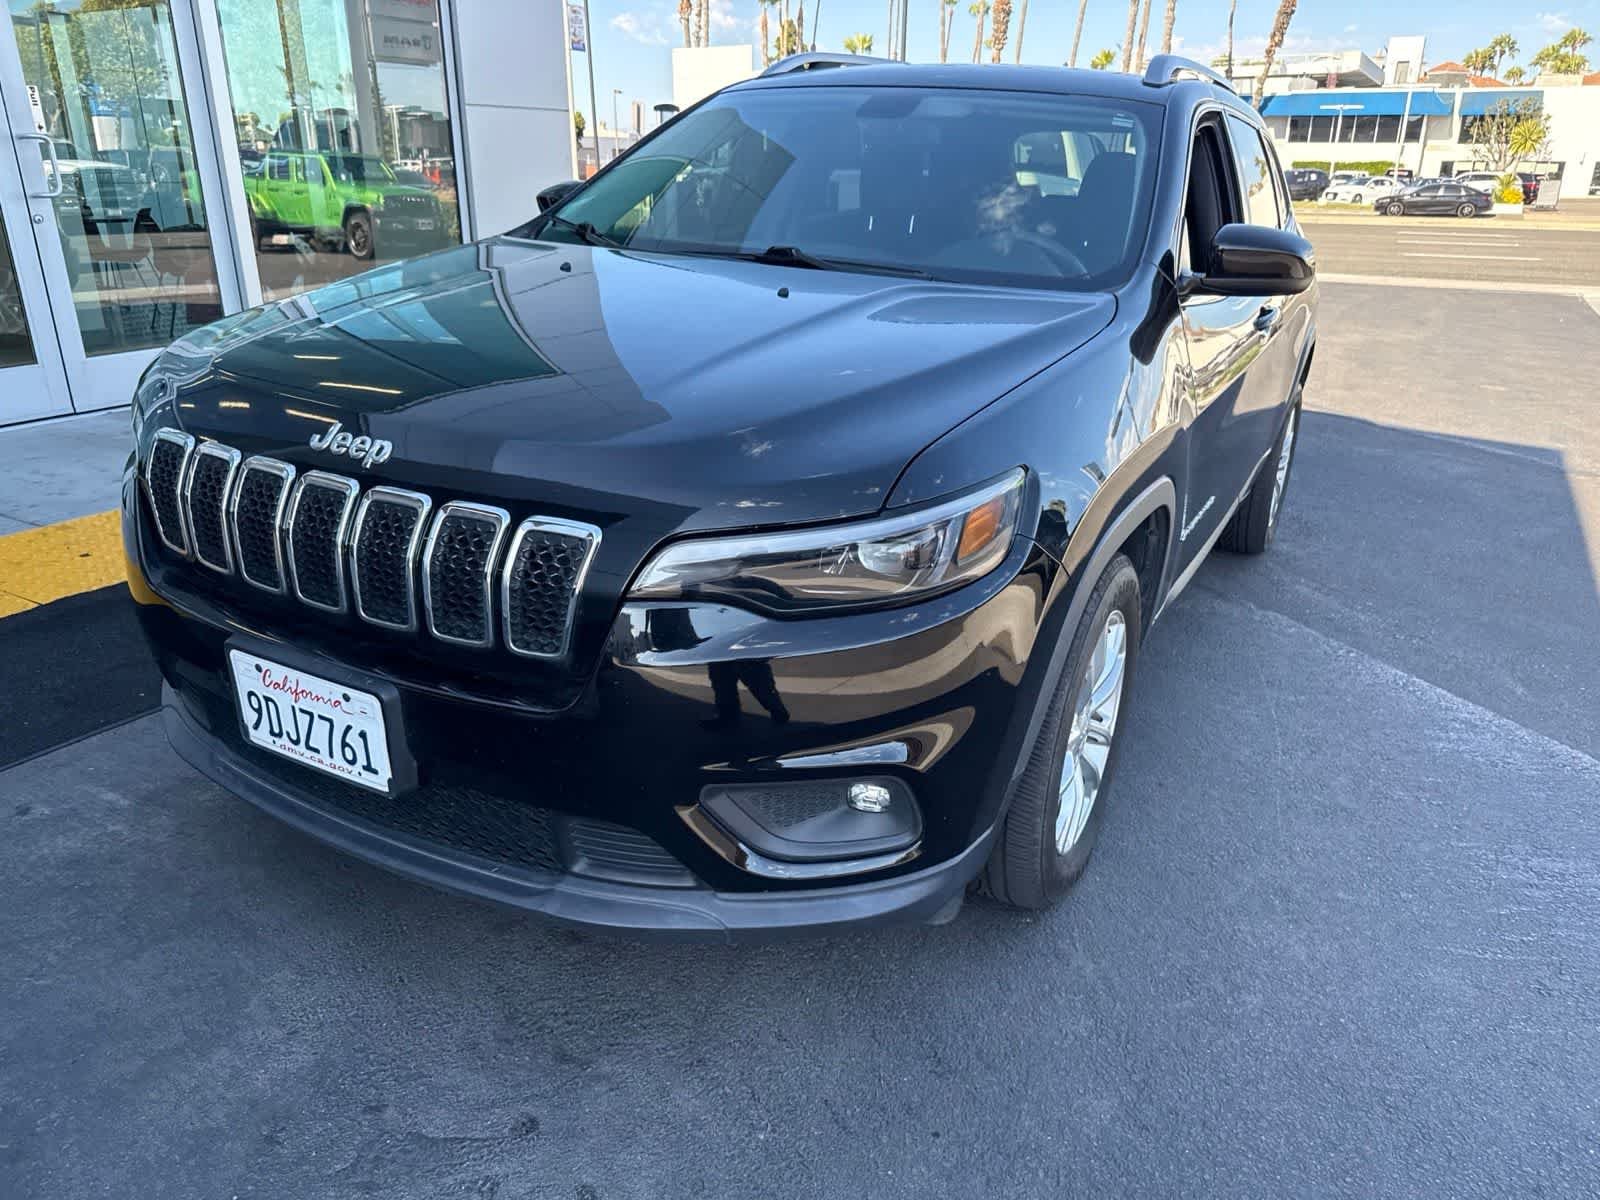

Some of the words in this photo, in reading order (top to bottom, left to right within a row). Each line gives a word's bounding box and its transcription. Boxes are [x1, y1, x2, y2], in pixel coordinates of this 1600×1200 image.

[28, 86, 39, 106] Pull
[310, 420, 393, 469] Jeep
[262, 668, 354, 716] California
[247, 690, 379, 775] 9DJZ761
[279, 743, 353, 776] dmv.ca.gov
